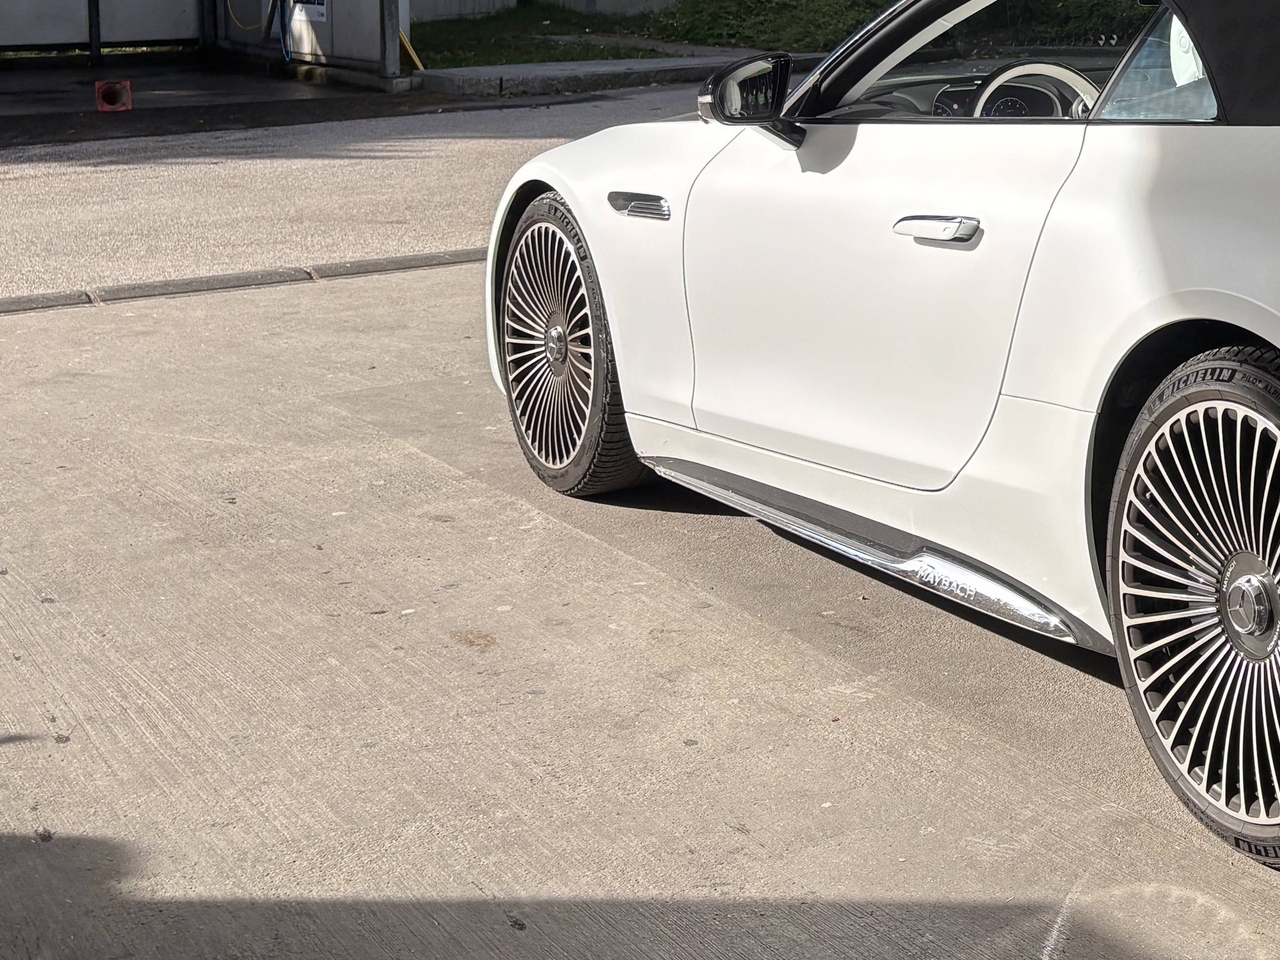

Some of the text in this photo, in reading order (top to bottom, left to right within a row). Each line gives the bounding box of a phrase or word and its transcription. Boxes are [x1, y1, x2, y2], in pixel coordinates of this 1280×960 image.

[556, 208, 588, 259] MICHELIN
[1162, 367, 1233, 399] MICHELIN
[1241, 373, 1263, 388] PILOT
[916, 565, 977, 601] MAYBACH
[1222, 560, 1237, 592] MAYBACH
